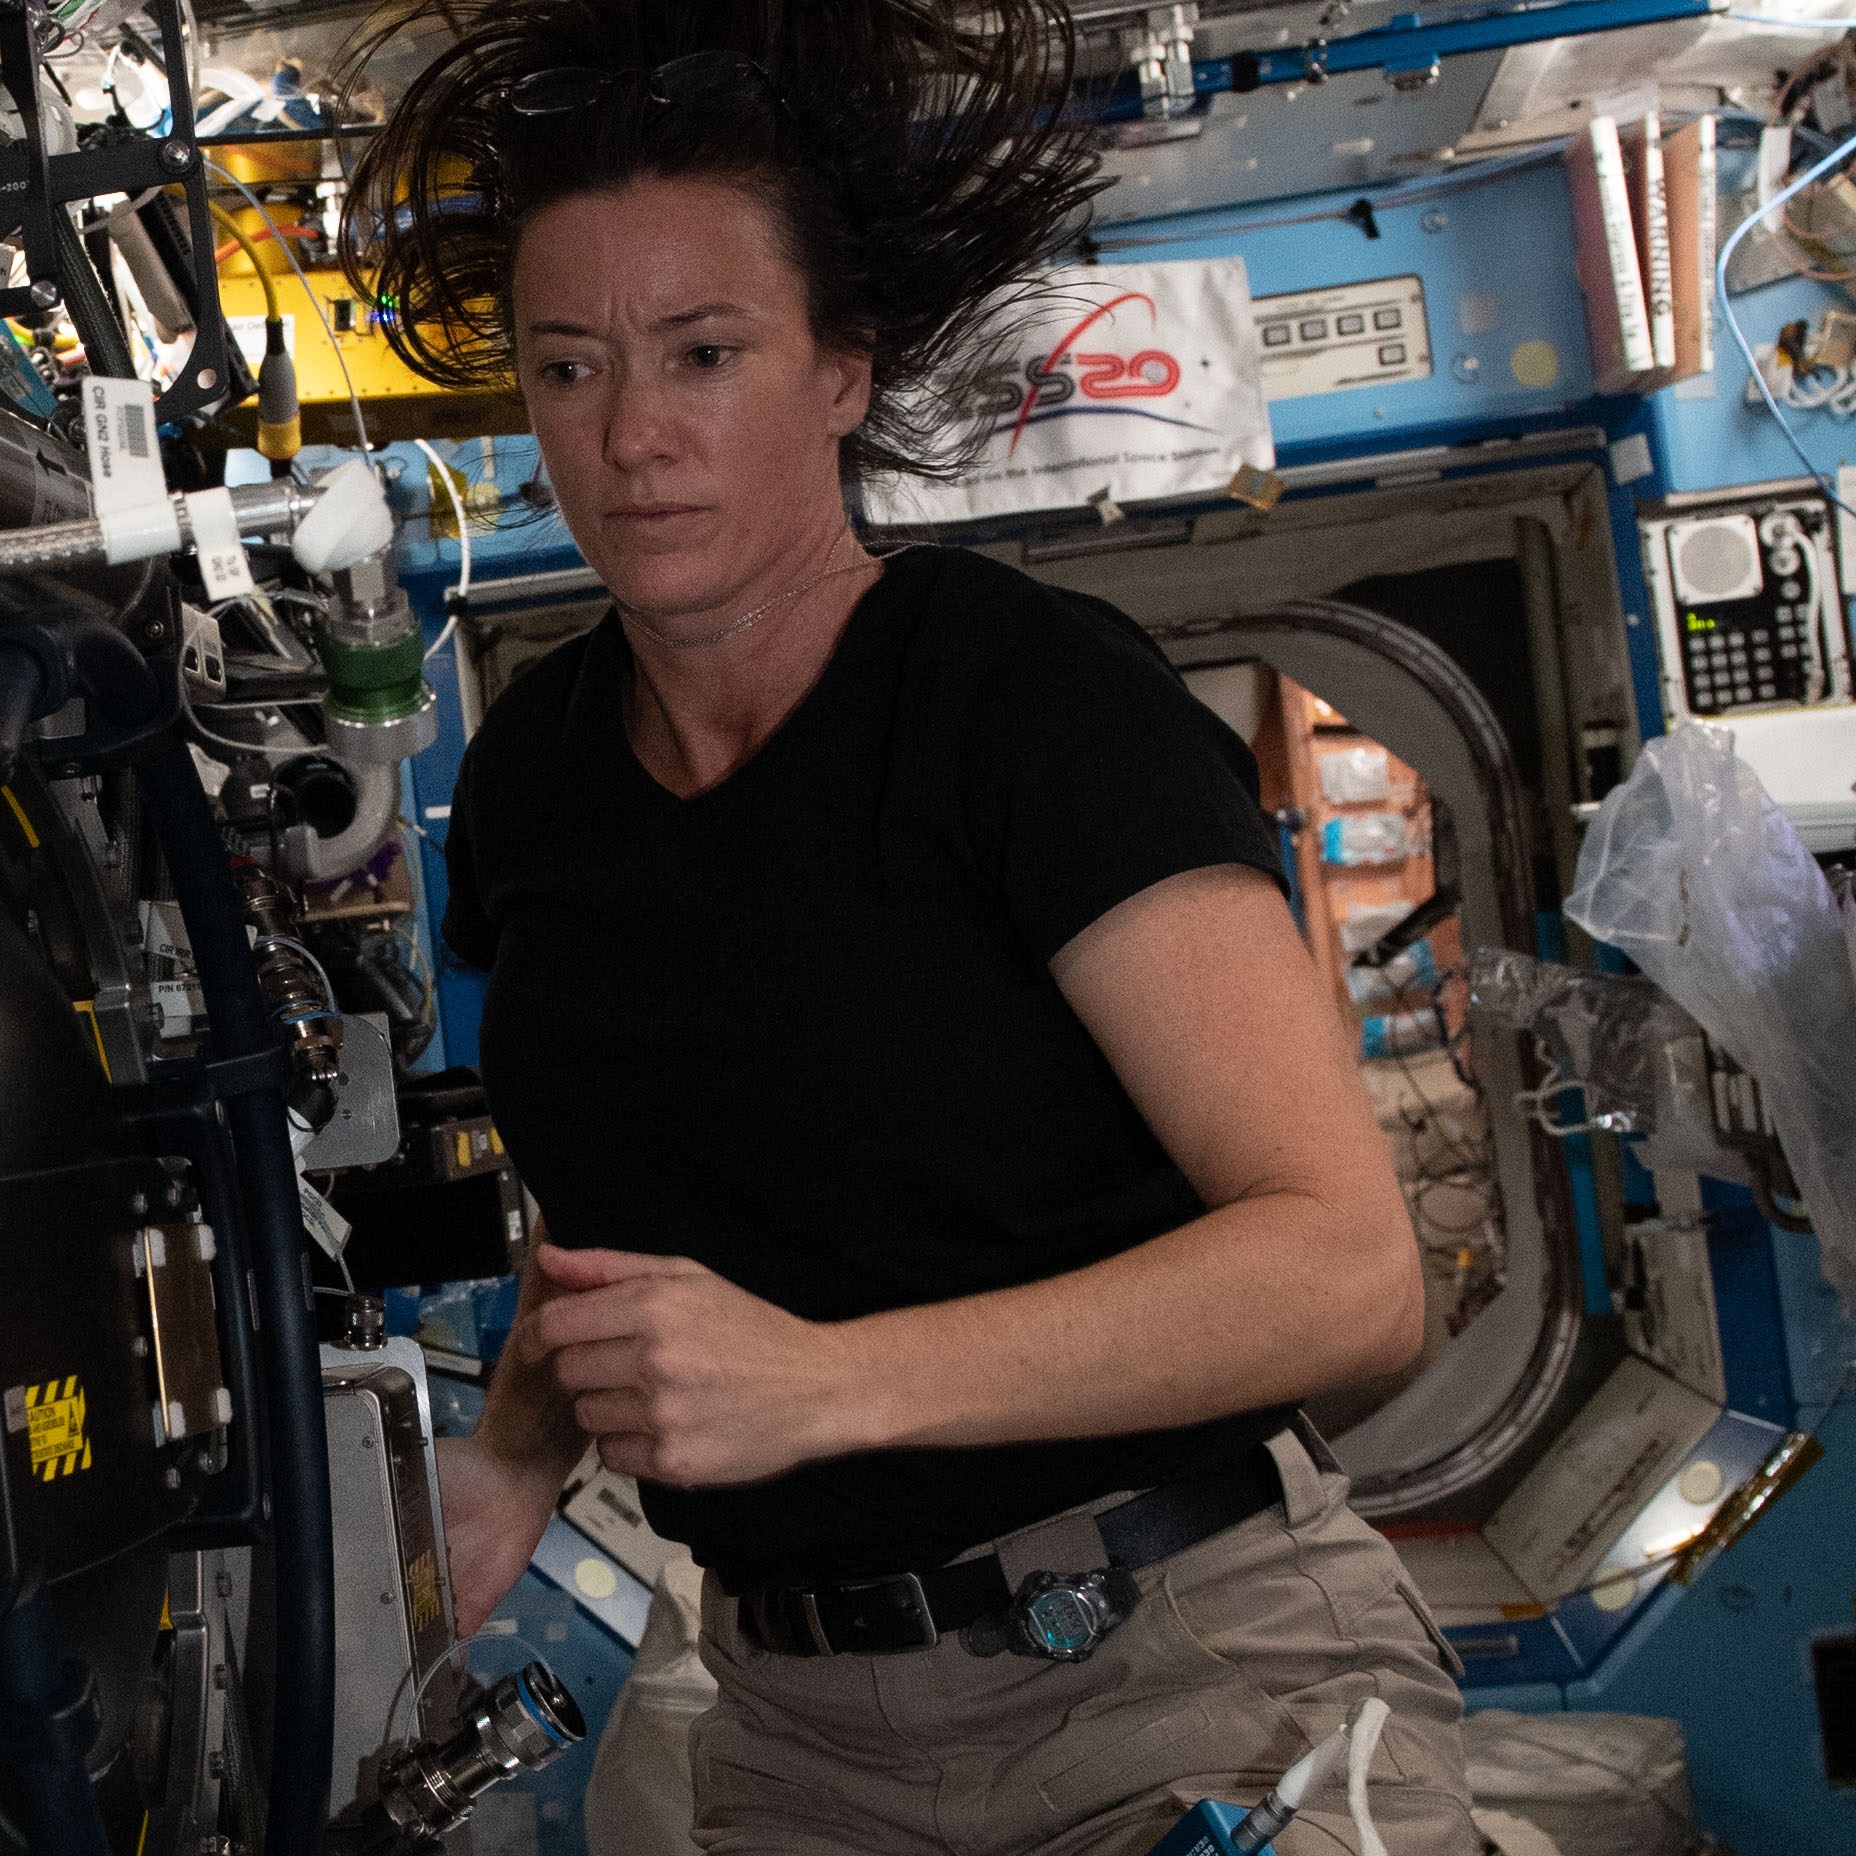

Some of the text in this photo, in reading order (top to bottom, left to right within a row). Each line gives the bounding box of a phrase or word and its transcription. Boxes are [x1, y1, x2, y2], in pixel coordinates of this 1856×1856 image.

[1645, 177, 1674, 320] WARNING
[91, 385, 113, 478] CIR GN2 Hose
